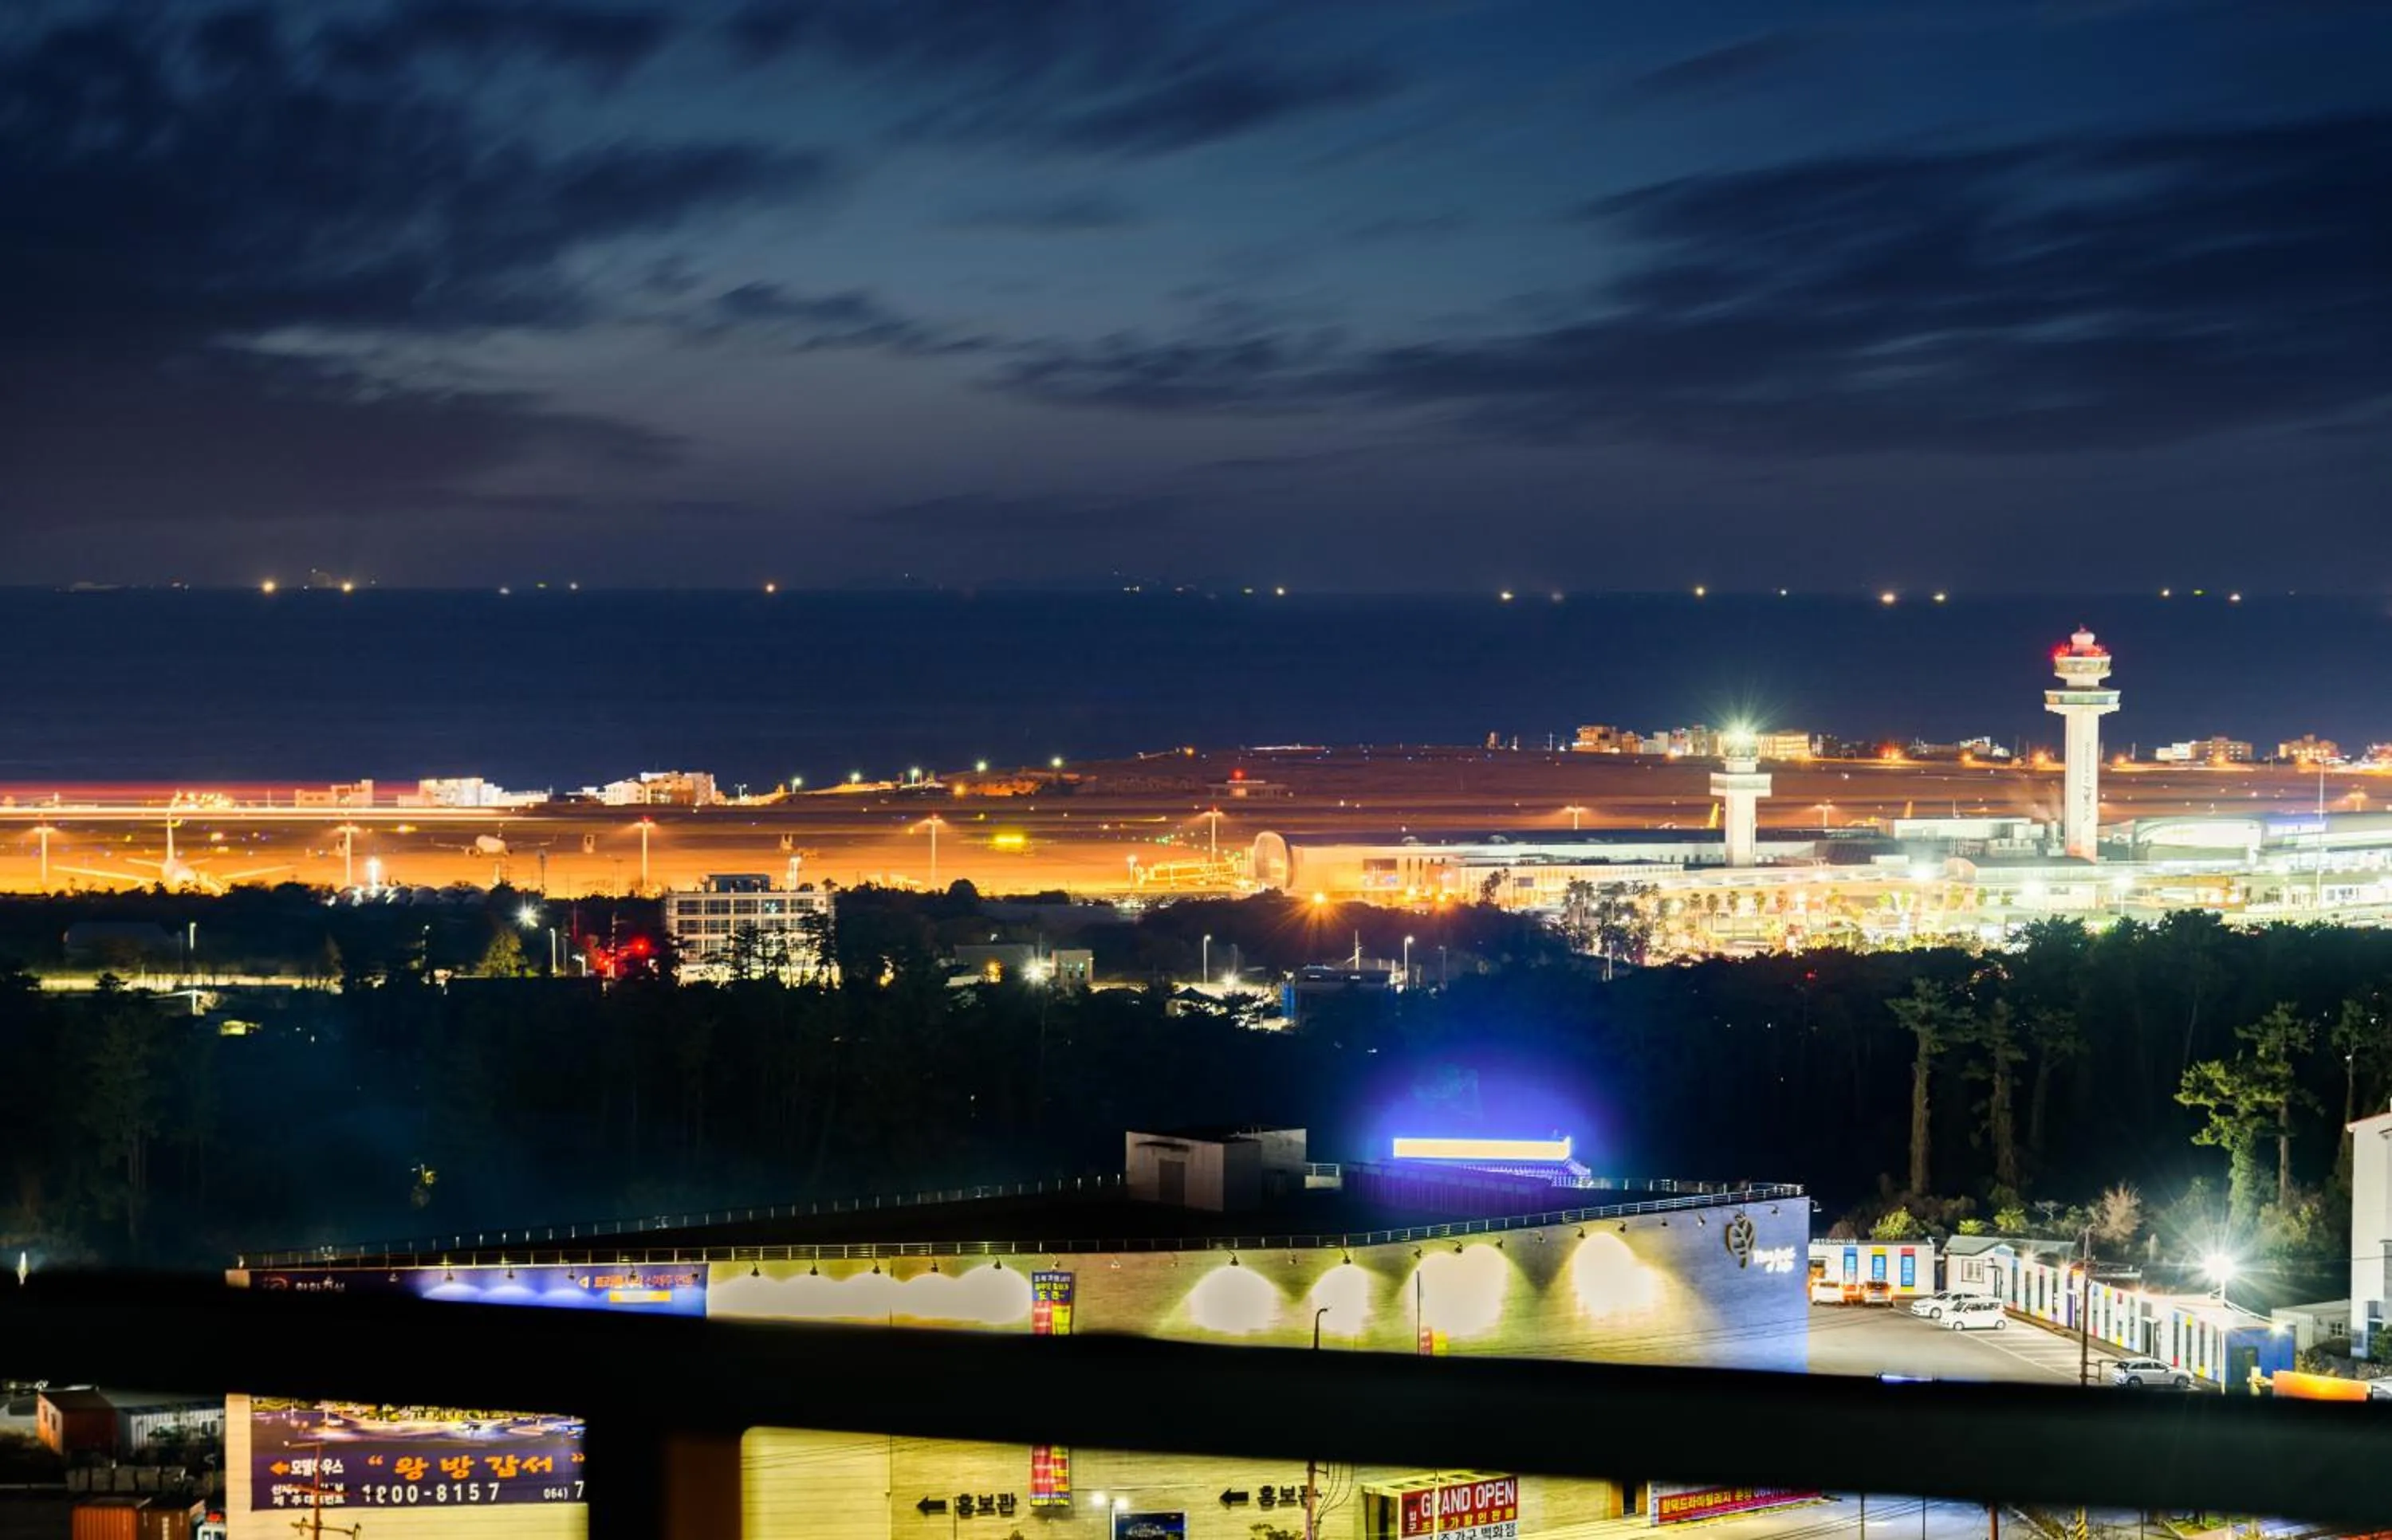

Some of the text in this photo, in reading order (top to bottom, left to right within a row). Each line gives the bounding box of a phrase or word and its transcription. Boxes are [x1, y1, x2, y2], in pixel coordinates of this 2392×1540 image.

[290, 1458, 344, 1476] 모델우스
[394, 1456, 429, 1480] 왕
[440, 1455, 475, 1479] 방
[957, 1492, 1017, 1516] 홍보관
[1421, 1480, 1515, 1518] GRAND OPEN
